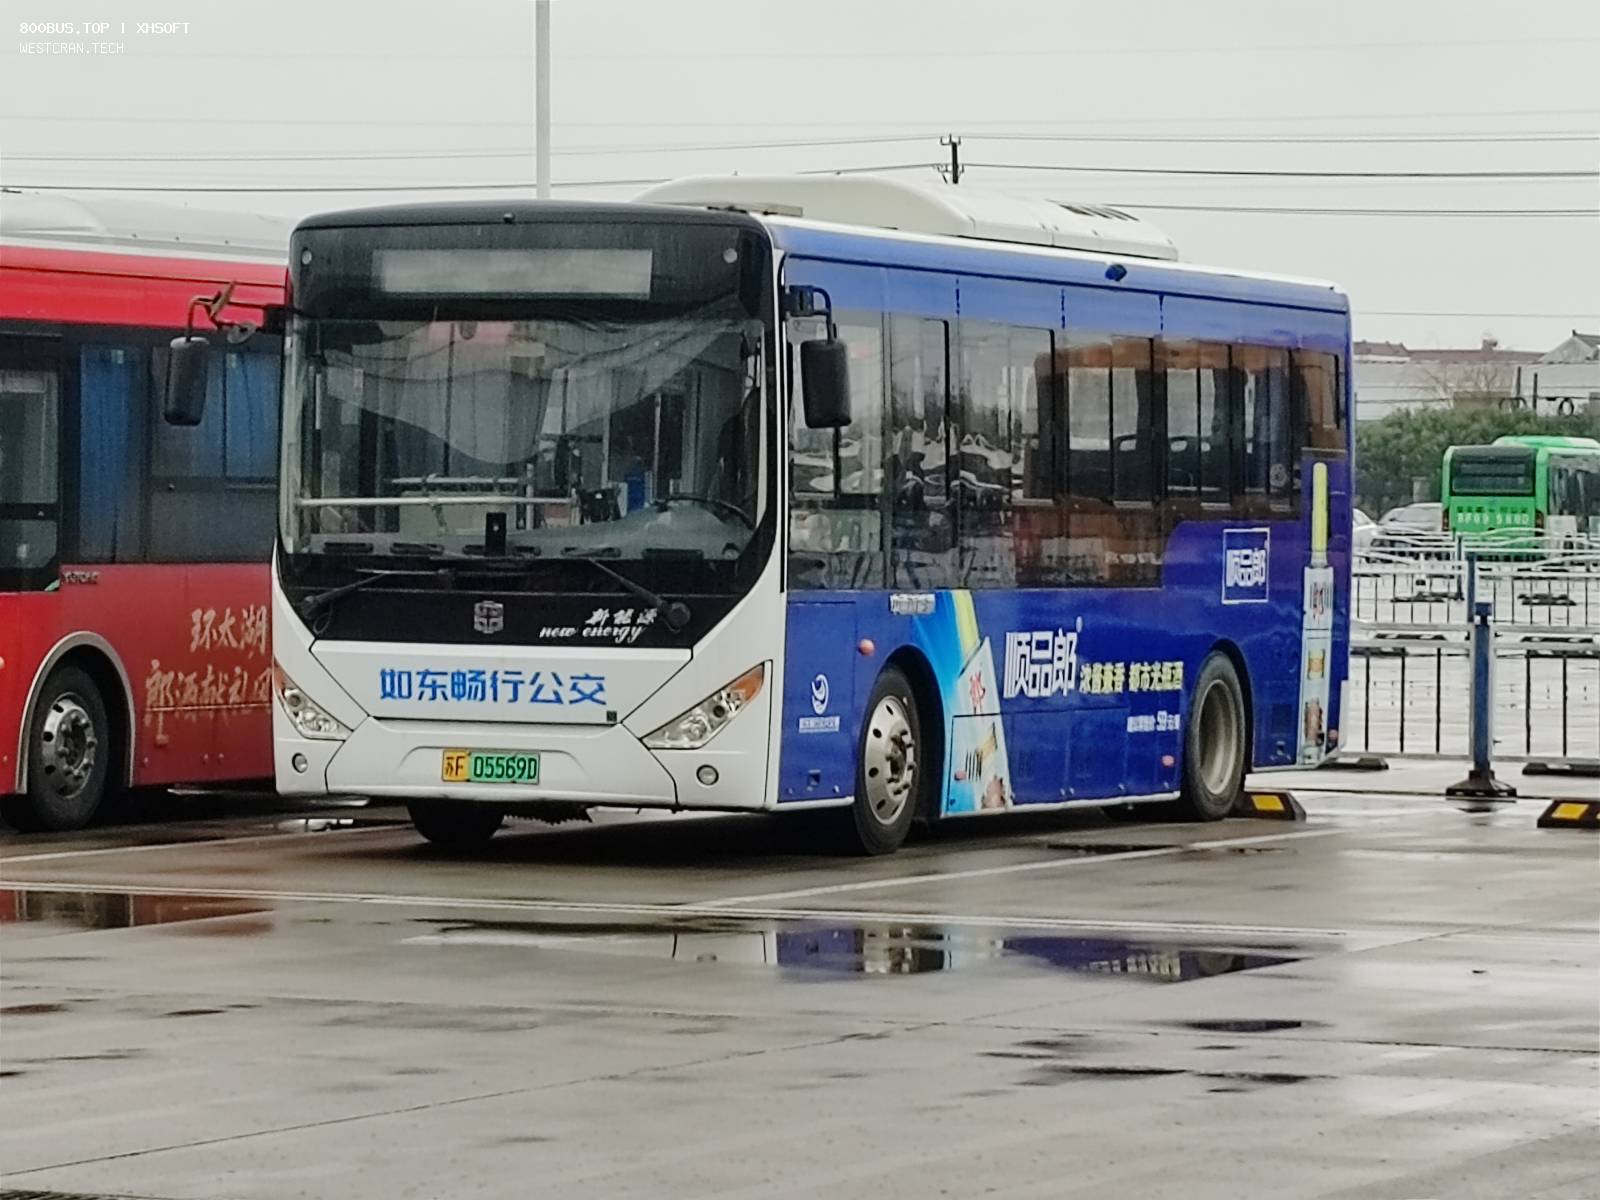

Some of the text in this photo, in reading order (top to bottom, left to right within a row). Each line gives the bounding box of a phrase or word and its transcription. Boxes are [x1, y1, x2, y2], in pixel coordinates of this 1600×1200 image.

[1226, 548, 1266, 587] 顺品郎
[585, 608, 658, 625] 新能源
[539, 625, 644, 644] new energy
[1003, 628, 1078, 699] 顺品郎
[380, 668, 607, 706] 如东畅行公交
[473, 756, 538, 779] 05569D
